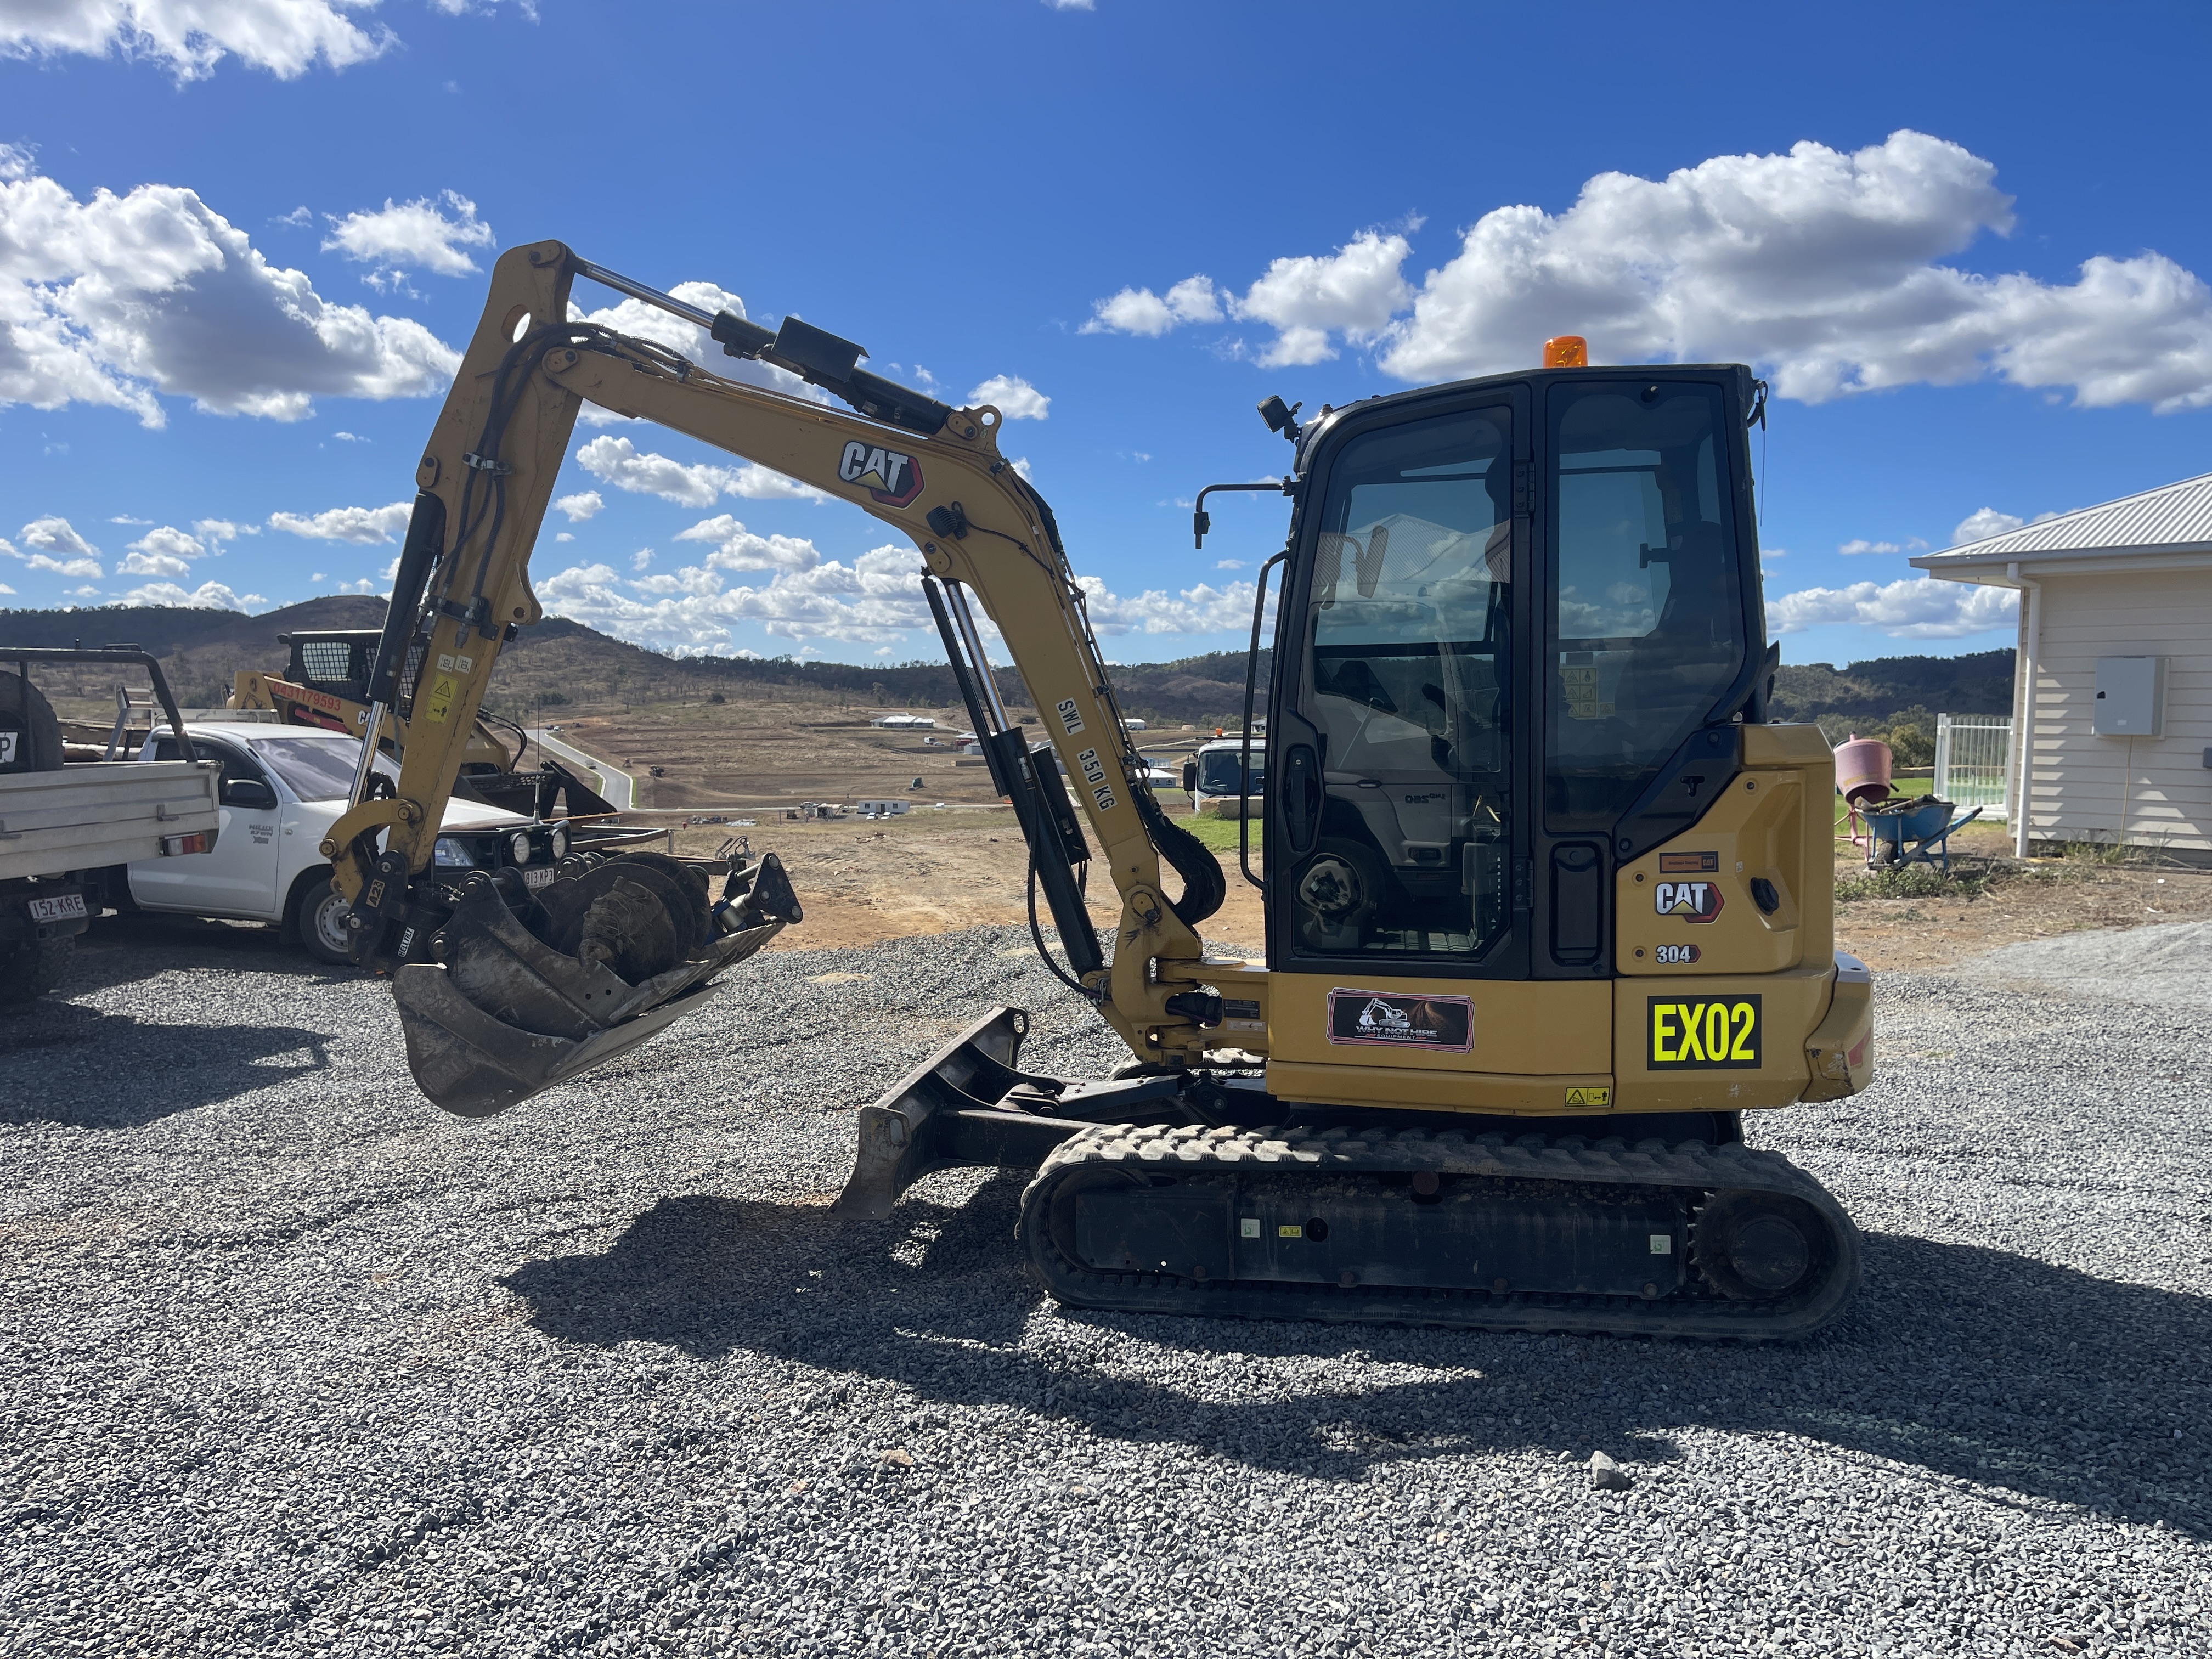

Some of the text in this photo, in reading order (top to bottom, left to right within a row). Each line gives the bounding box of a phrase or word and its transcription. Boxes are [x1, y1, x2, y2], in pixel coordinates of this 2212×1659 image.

[840, 442, 909, 493] CAT
[273, 682, 341, 712] 0431179593
[1058, 700, 1115, 811] SWL 350 KG
[1657, 883, 1708, 915] CAT
[1657, 946, 1691, 963] 304
[1385, 1027, 1409, 1035] NOT
[1410, 1029, 1437, 1037] HIRE
[1654, 1002, 1755, 1062] EX02
